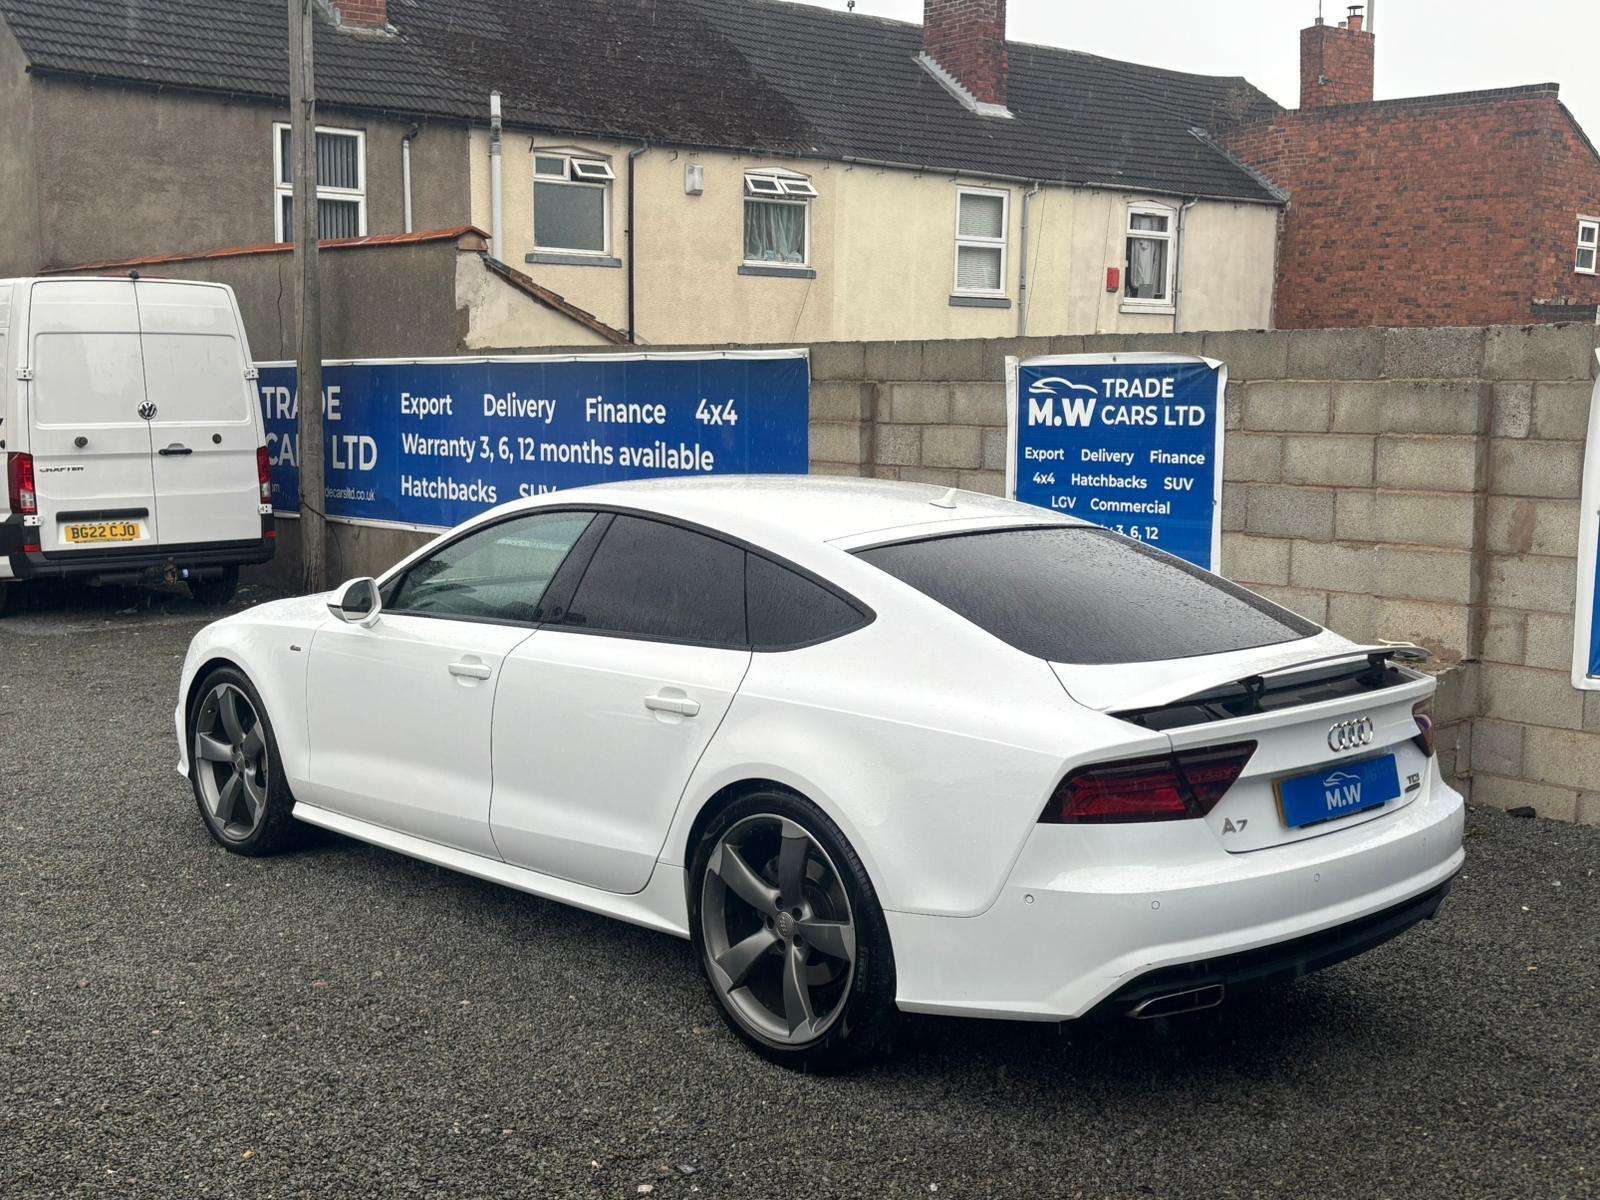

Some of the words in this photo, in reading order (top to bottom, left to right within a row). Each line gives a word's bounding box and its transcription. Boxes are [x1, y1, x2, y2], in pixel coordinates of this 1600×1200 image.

[1101, 376, 1175, 399] TRADE
[261, 385, 342, 421] TRE
[401, 392, 453, 420] Export
[483, 391, 557, 424] Delivery
[585, 395, 667, 425] Finance
[695, 398, 738, 426] 4x4
[1028, 397, 1097, 427] M.W
[1101, 404, 1158, 426] CARS
[1164, 405, 1206, 426] LTD
[332, 435, 378, 471] LTD
[401, 432, 477, 464] Warranty
[479, 435, 495, 464] 3,
[498, 435, 514, 465] 6,
[517, 437, 536, 461] 12
[540, 439, 614, 466] months
[619, 440, 715, 472] available
[1025, 446, 1065, 462] Export
[1081, 448, 1135, 466] Delivery
[1149, 449, 1206, 465] Finance
[400, 474, 498, 503] Hatchbacks
[1032, 471, 1056, 485] 4x4
[1071, 473, 1148, 489] Hatchbacks
[1163, 476, 1194, 491] SUV
[1051, 496, 1077, 509] LGV
[1090, 497, 1171, 515] Commercial
[71, 526, 106, 538] BG22
[110, 524, 135, 536] CJO
[1129, 524, 1142, 541] 6,
[1145, 526, 1159, 540] 12
[1325, 783, 1362, 810] M.W
[1221, 817, 1248, 835] A7
